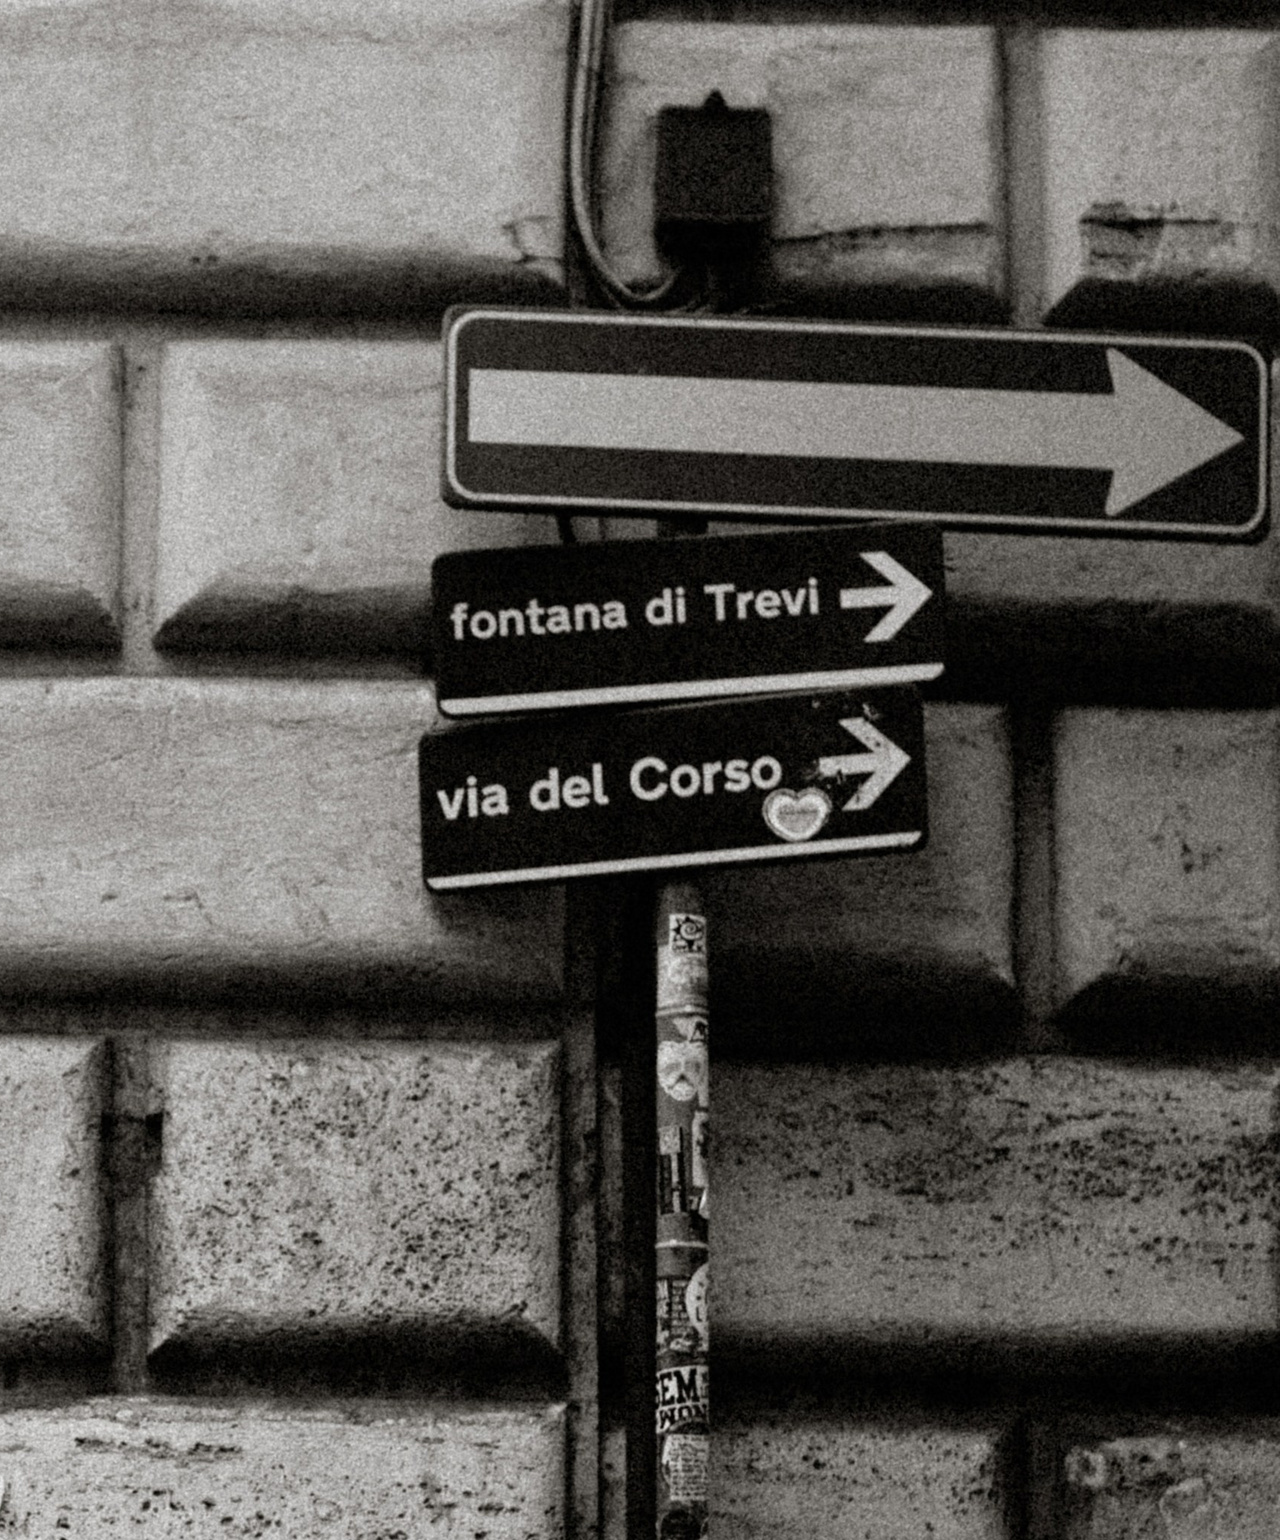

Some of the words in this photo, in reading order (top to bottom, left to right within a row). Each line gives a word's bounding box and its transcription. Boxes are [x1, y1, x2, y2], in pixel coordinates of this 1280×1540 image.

[450, 599, 628, 641] fontana
[645, 586, 687, 626] di
[703, 576, 820, 622] Trevi
[436, 774, 510, 821] via
[529, 762, 610, 812] del
[629, 754, 783, 801] Corso
